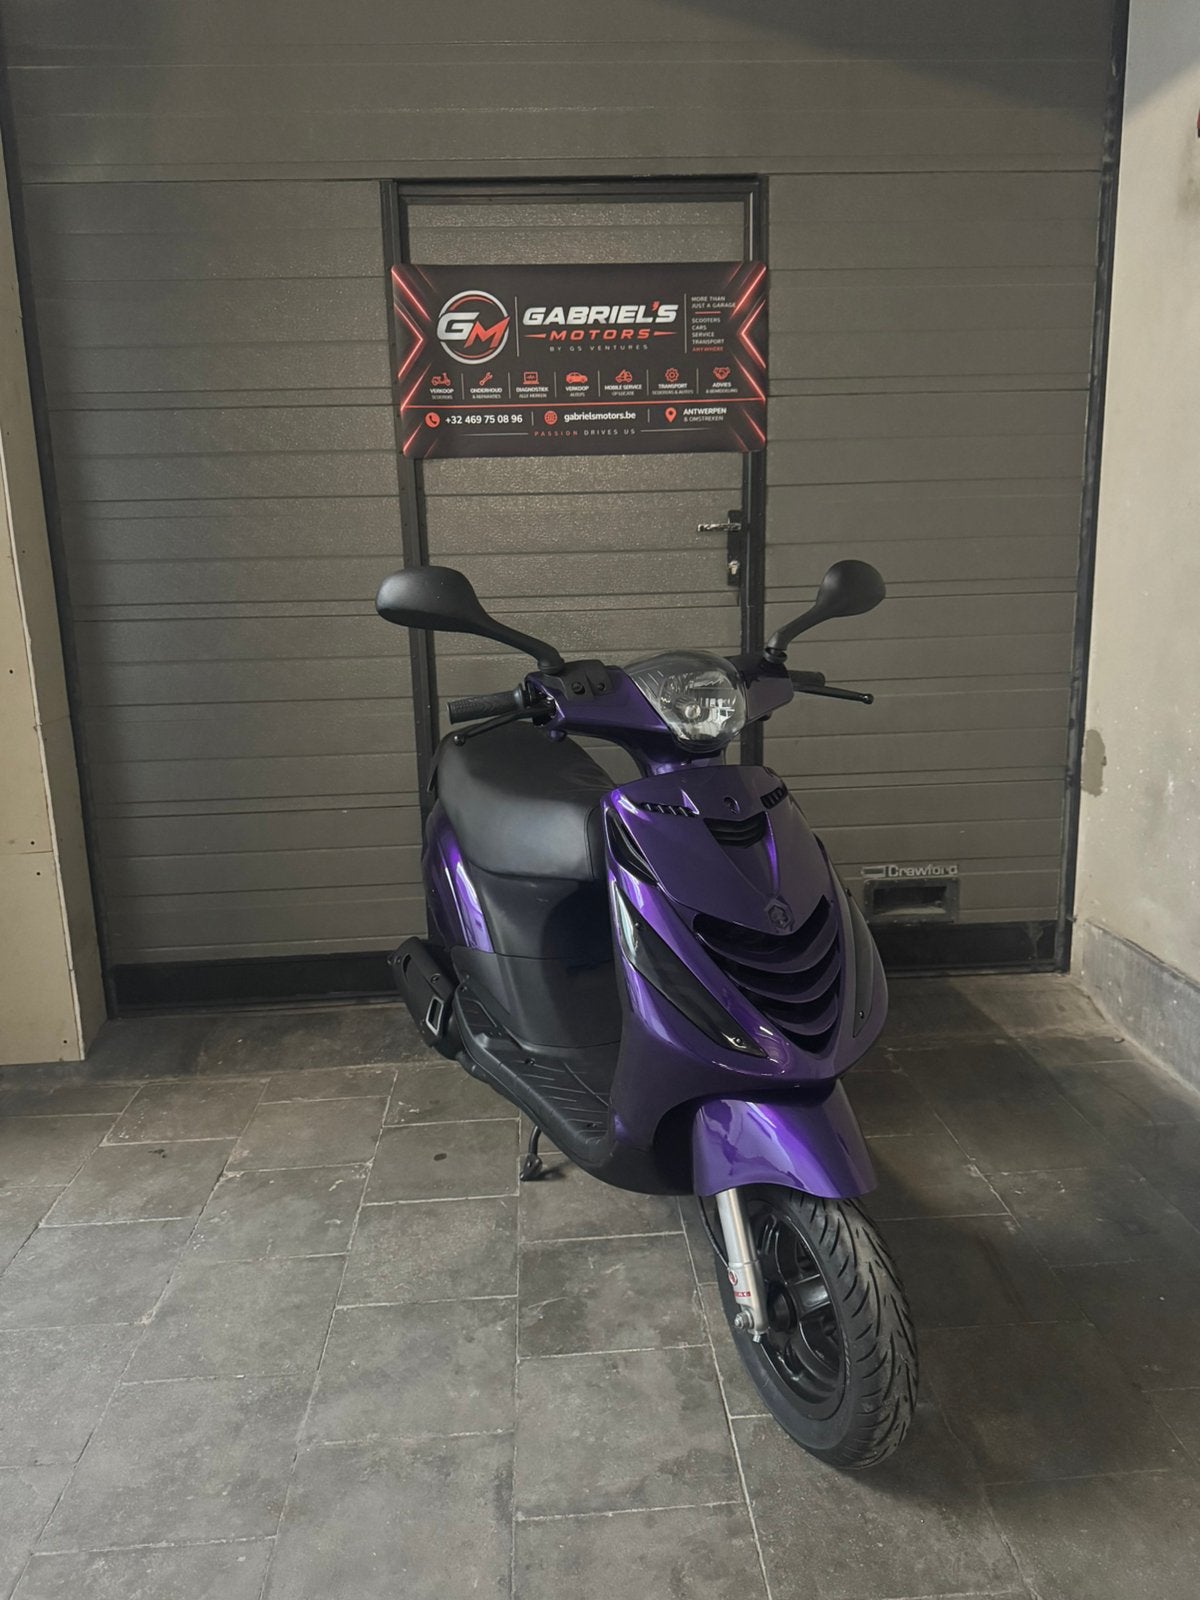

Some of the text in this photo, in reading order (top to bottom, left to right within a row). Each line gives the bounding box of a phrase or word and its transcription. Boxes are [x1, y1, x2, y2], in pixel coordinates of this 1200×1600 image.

[522, 301, 679, 326] GABRIEL'S
[436, 312, 511, 348] GM
[548, 328, 651, 342] MOTORS
[564, 411, 636, 422] gabrielsmotors.be
[682, 408, 726, 416] ANTWERPEN
[445, 414, 523, 424] +32 469 75 08 96
[888, 864, 958, 877] Crawford
